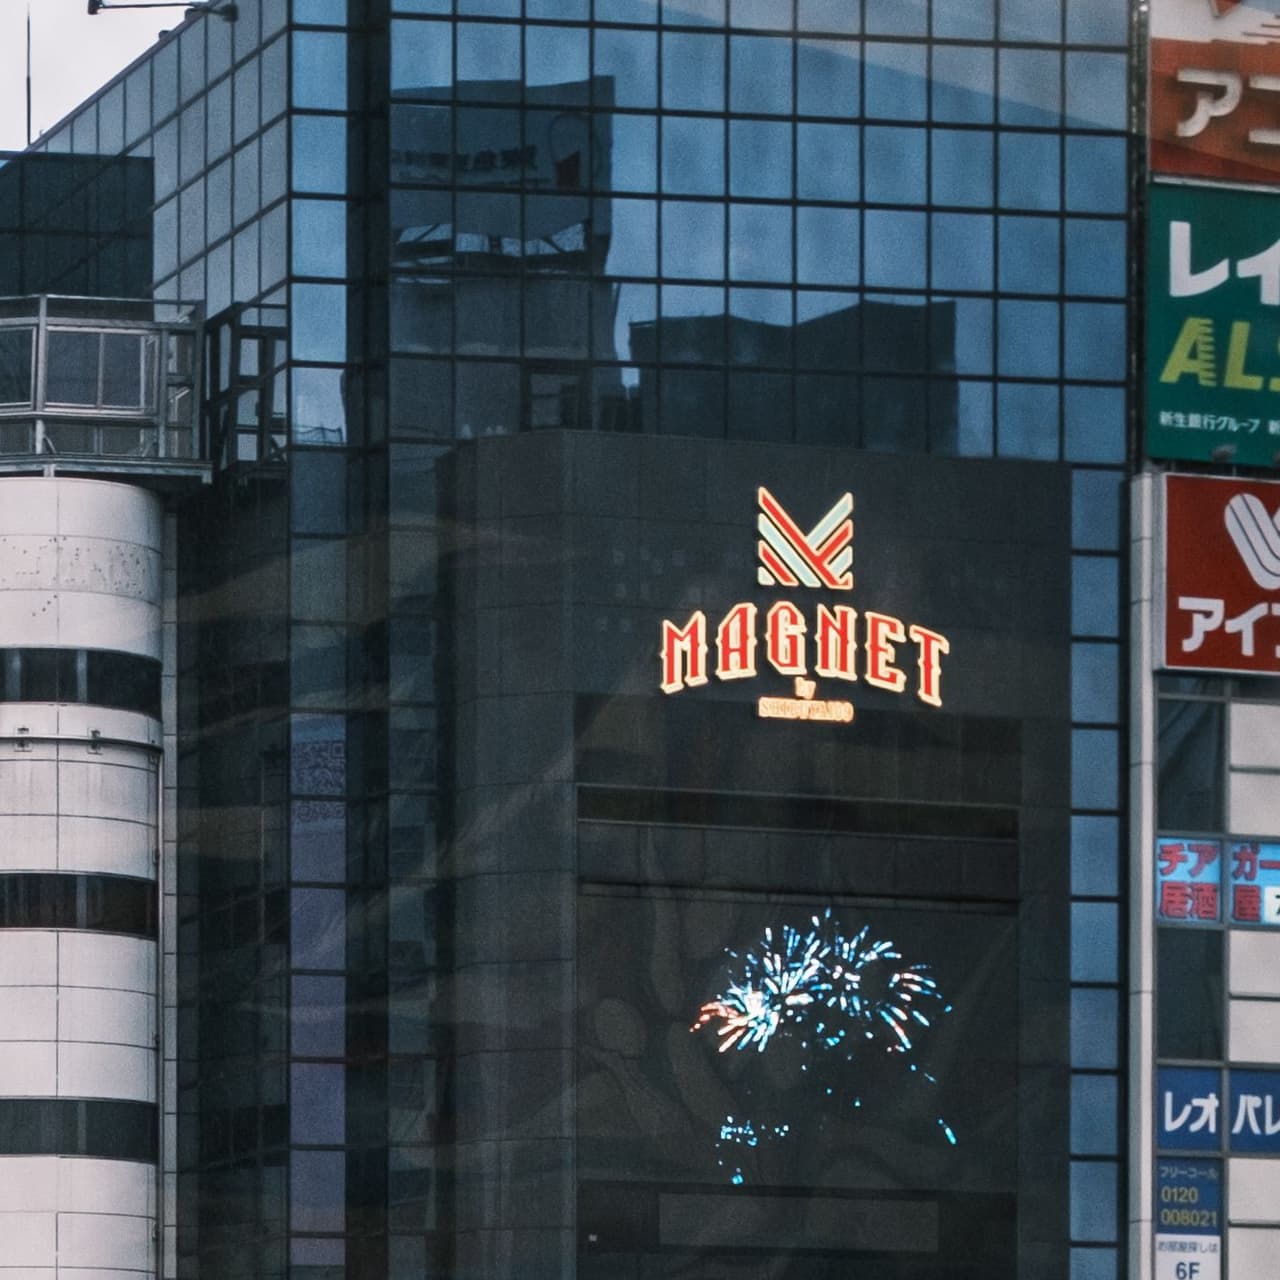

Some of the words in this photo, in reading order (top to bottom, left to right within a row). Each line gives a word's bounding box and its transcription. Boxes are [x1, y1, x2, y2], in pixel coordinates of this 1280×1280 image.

[1159, 317, 1280, 391] AL
[660, 600, 950, 707] MAGNET
[1178, 596, 1280, 657] アイ
[1160, 1186, 1199, 1204] 0120
[1175, 1262, 1201, 1280] 6F
